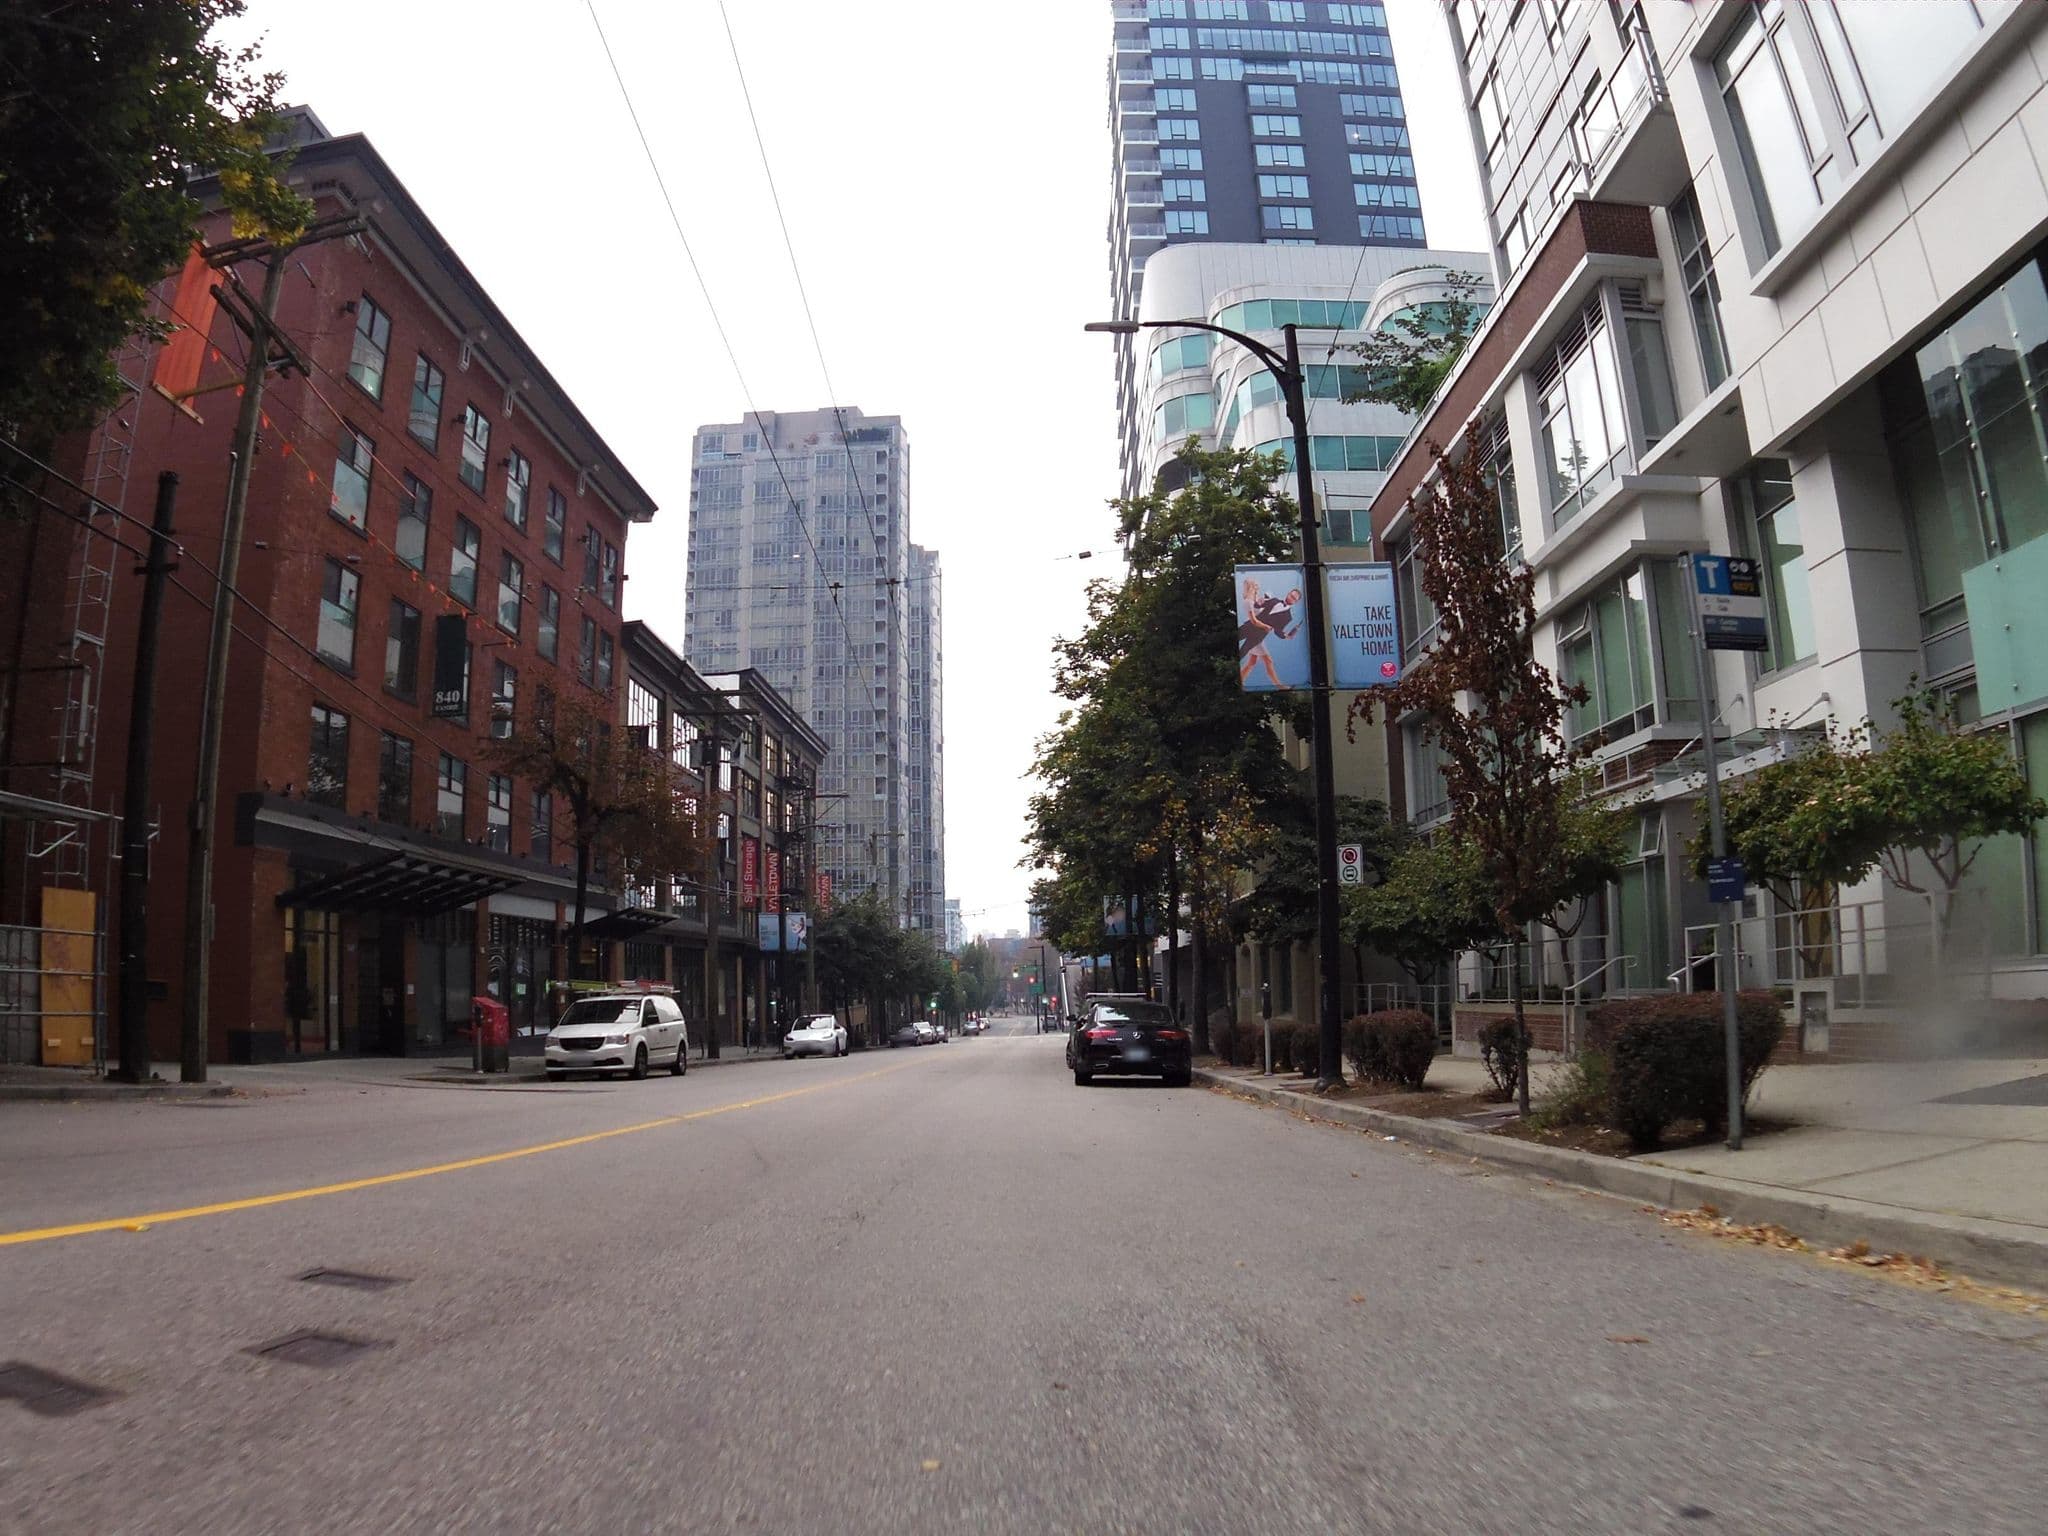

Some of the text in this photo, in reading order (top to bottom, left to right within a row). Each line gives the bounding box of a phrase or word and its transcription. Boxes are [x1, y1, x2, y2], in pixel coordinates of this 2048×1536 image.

[1364, 605, 1392, 621] TAKE
[1333, 623, 1394, 640] YALETOWN
[1362, 640, 1395, 656] HOME
[436, 690, 460, 704] 840
[743, 840, 755, 881] Storage
[768, 852, 778, 911] YALETOWN
